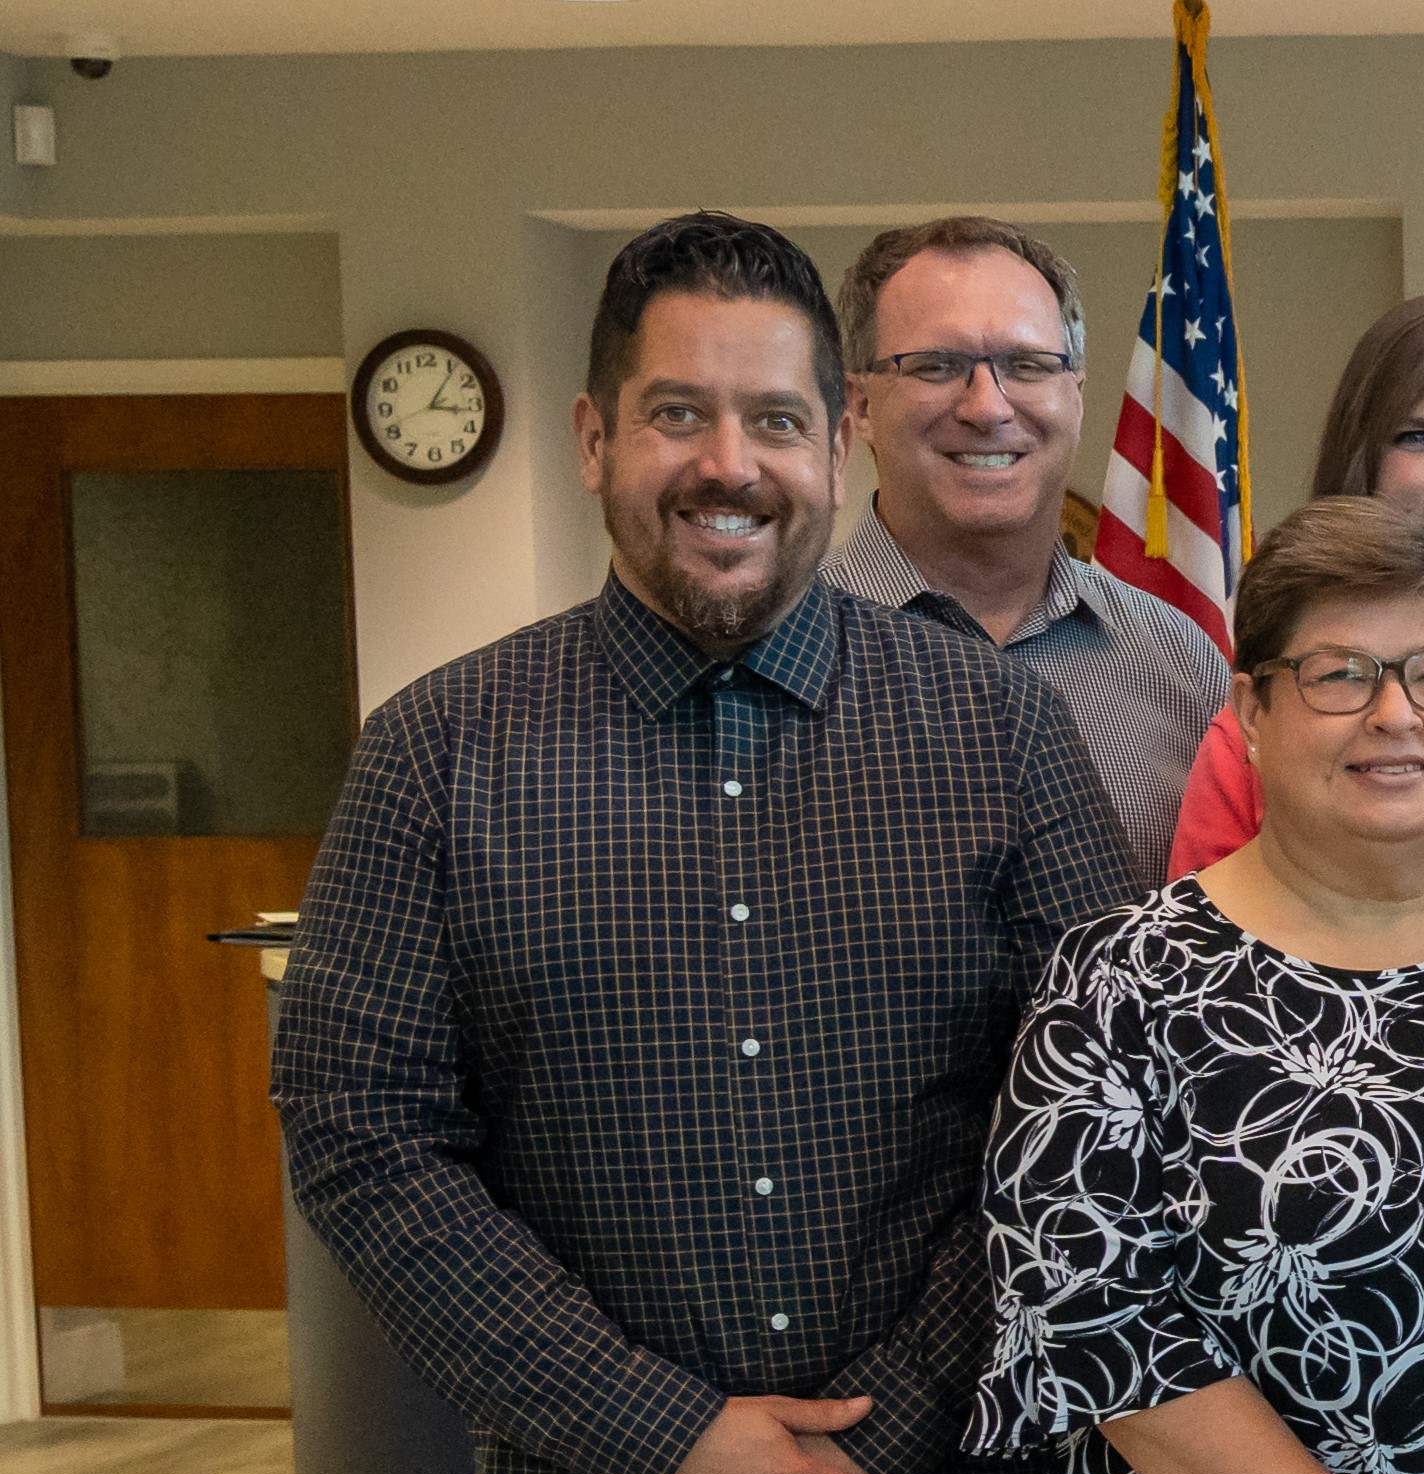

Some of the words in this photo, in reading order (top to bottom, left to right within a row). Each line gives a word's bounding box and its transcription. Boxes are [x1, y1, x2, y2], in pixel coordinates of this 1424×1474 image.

[397, 361, 412, 374] 11
[415, 352, 437, 368] 12
[446, 359, 454, 374] 1
[381, 377, 398, 393] 10
[460, 374, 476, 388] 2
[377, 402, 393, 418] 9
[468, 397, 483, 412] 3
[386, 425, 401, 440] 8
[463, 420, 477, 434] 4
[405, 443, 417, 457] 7
[450, 438, 465, 454] 5
[427, 447, 442, 462] 6
